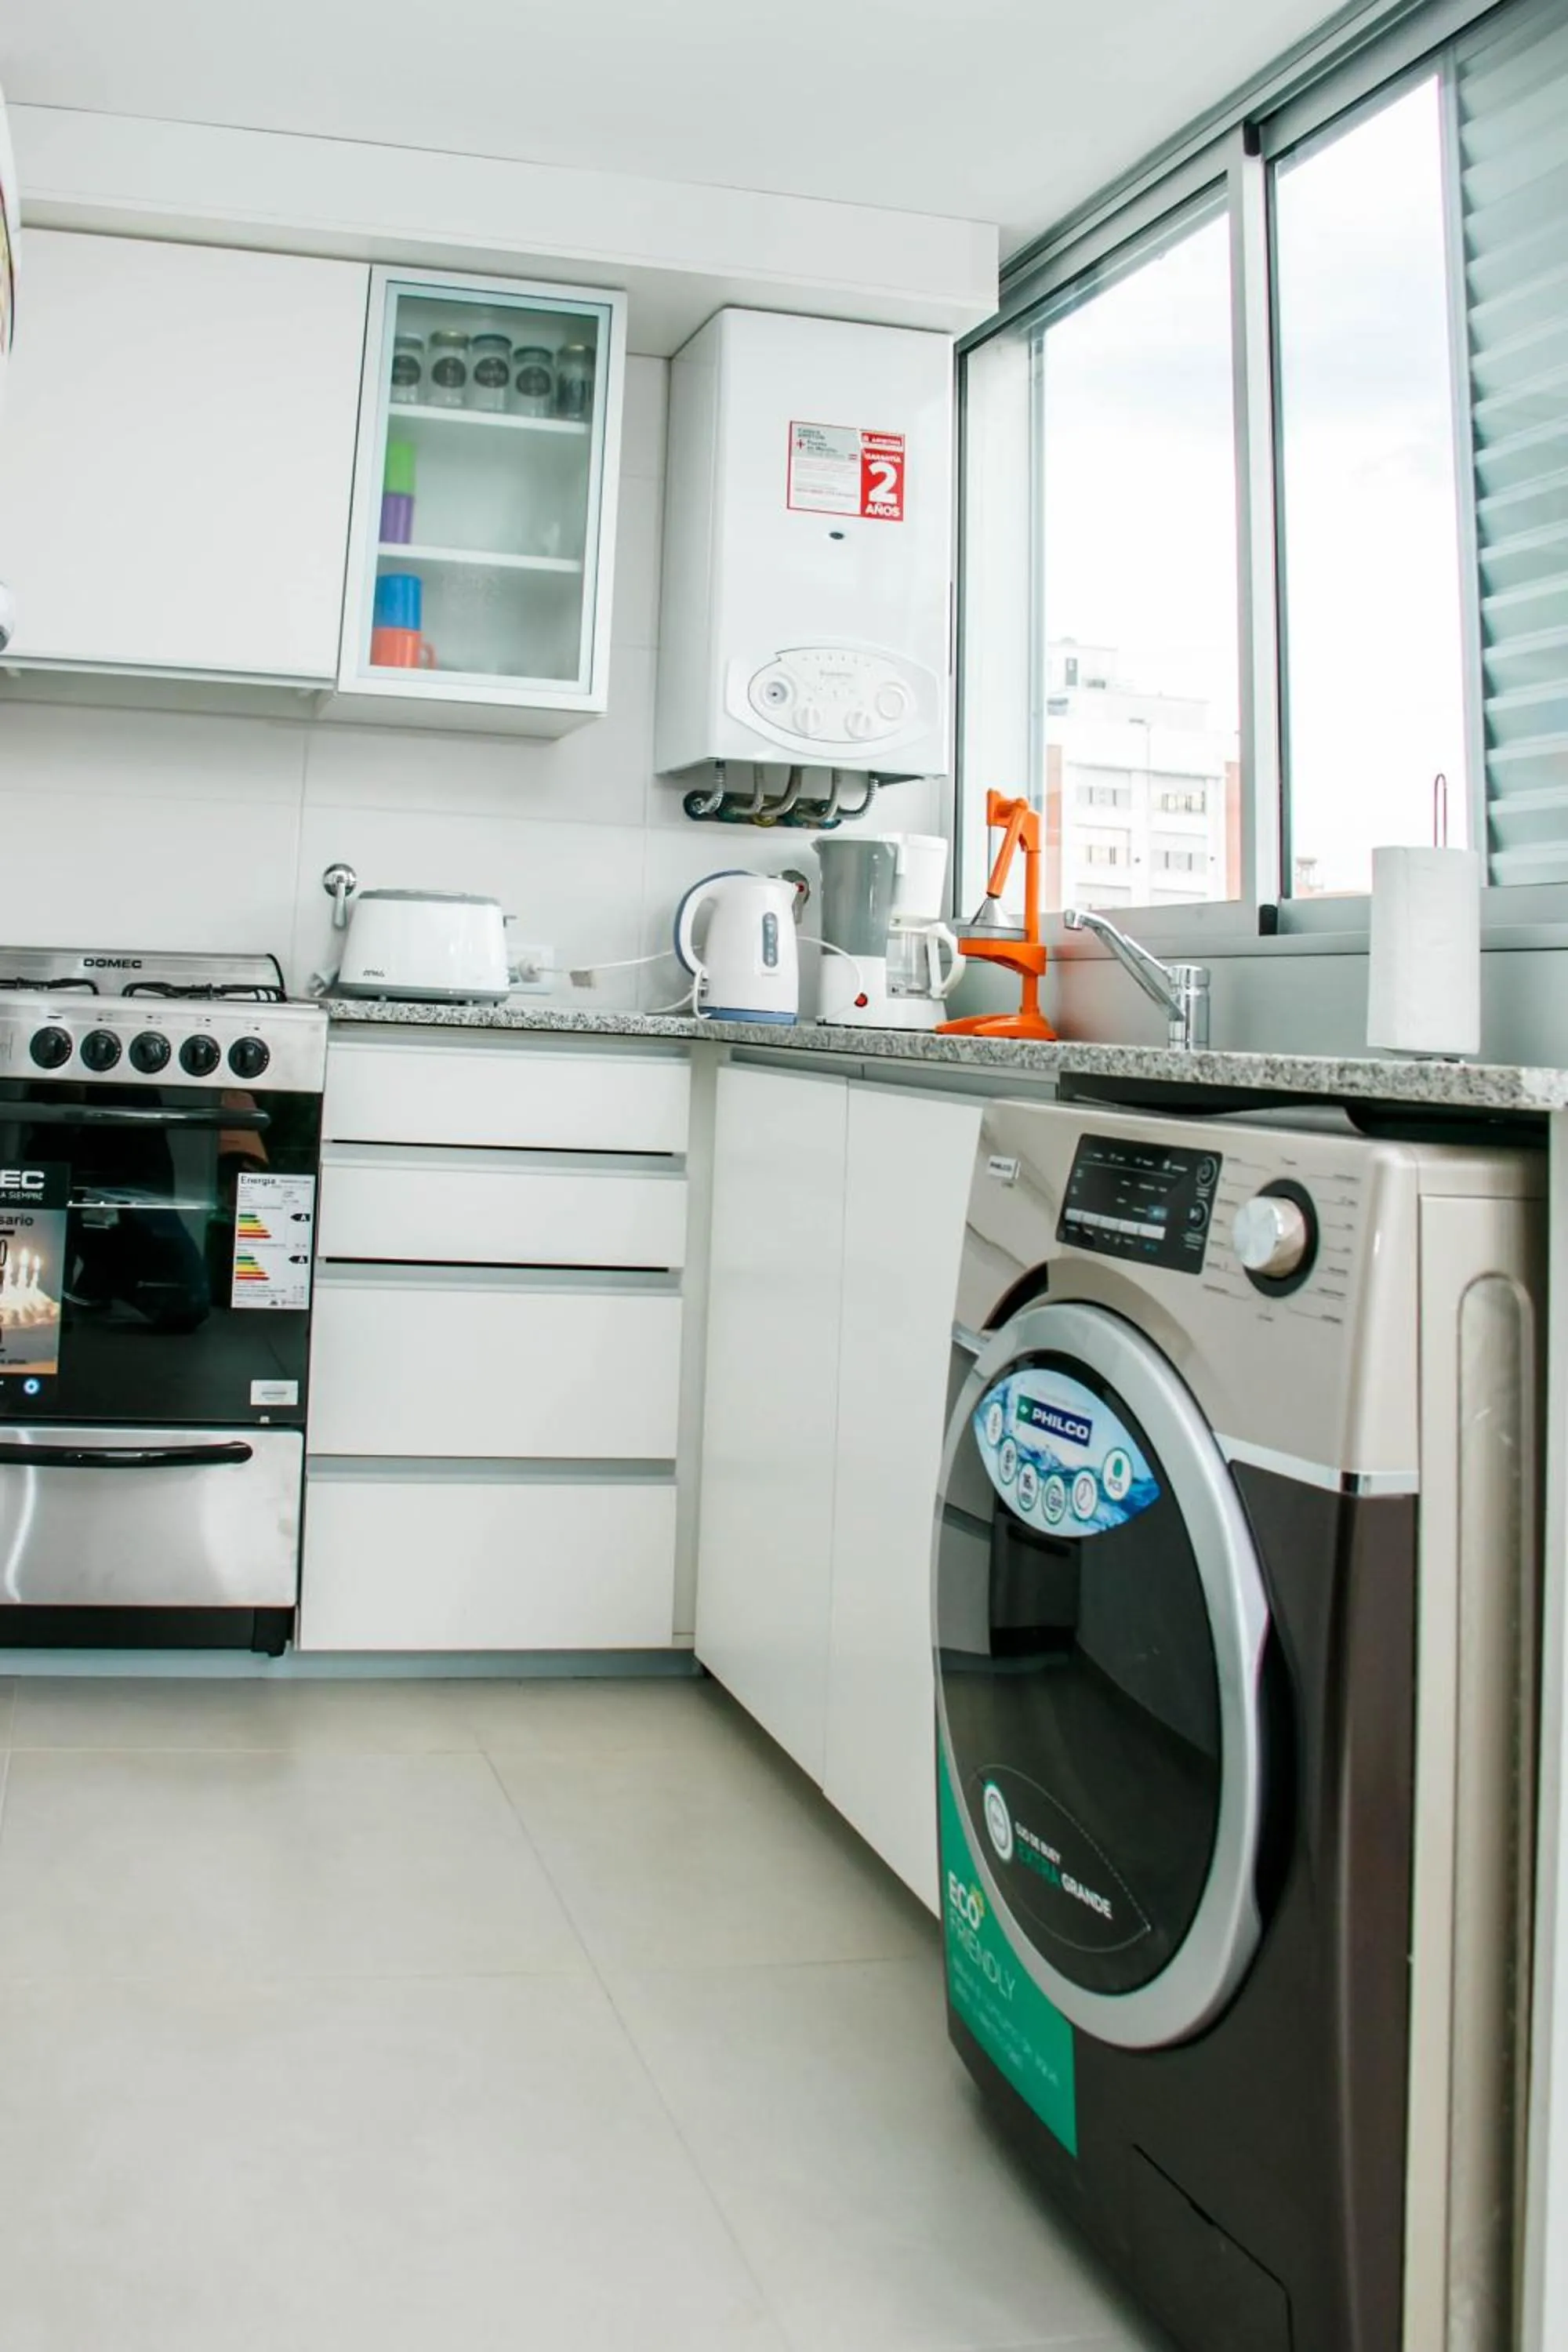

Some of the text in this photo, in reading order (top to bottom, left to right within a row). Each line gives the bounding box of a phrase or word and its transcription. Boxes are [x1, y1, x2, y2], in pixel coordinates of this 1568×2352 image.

[868, 462, 898, 504] 2
[866, 503, 900, 517] AÑOS
[84, 958, 142, 969] DOMEC
[0, 1170, 45, 1189] EC
[1032, 1406, 1089, 1440] PHILCO
[948, 1870, 980, 1931] ECO
[1062, 1872, 1113, 1920] GRANDE
